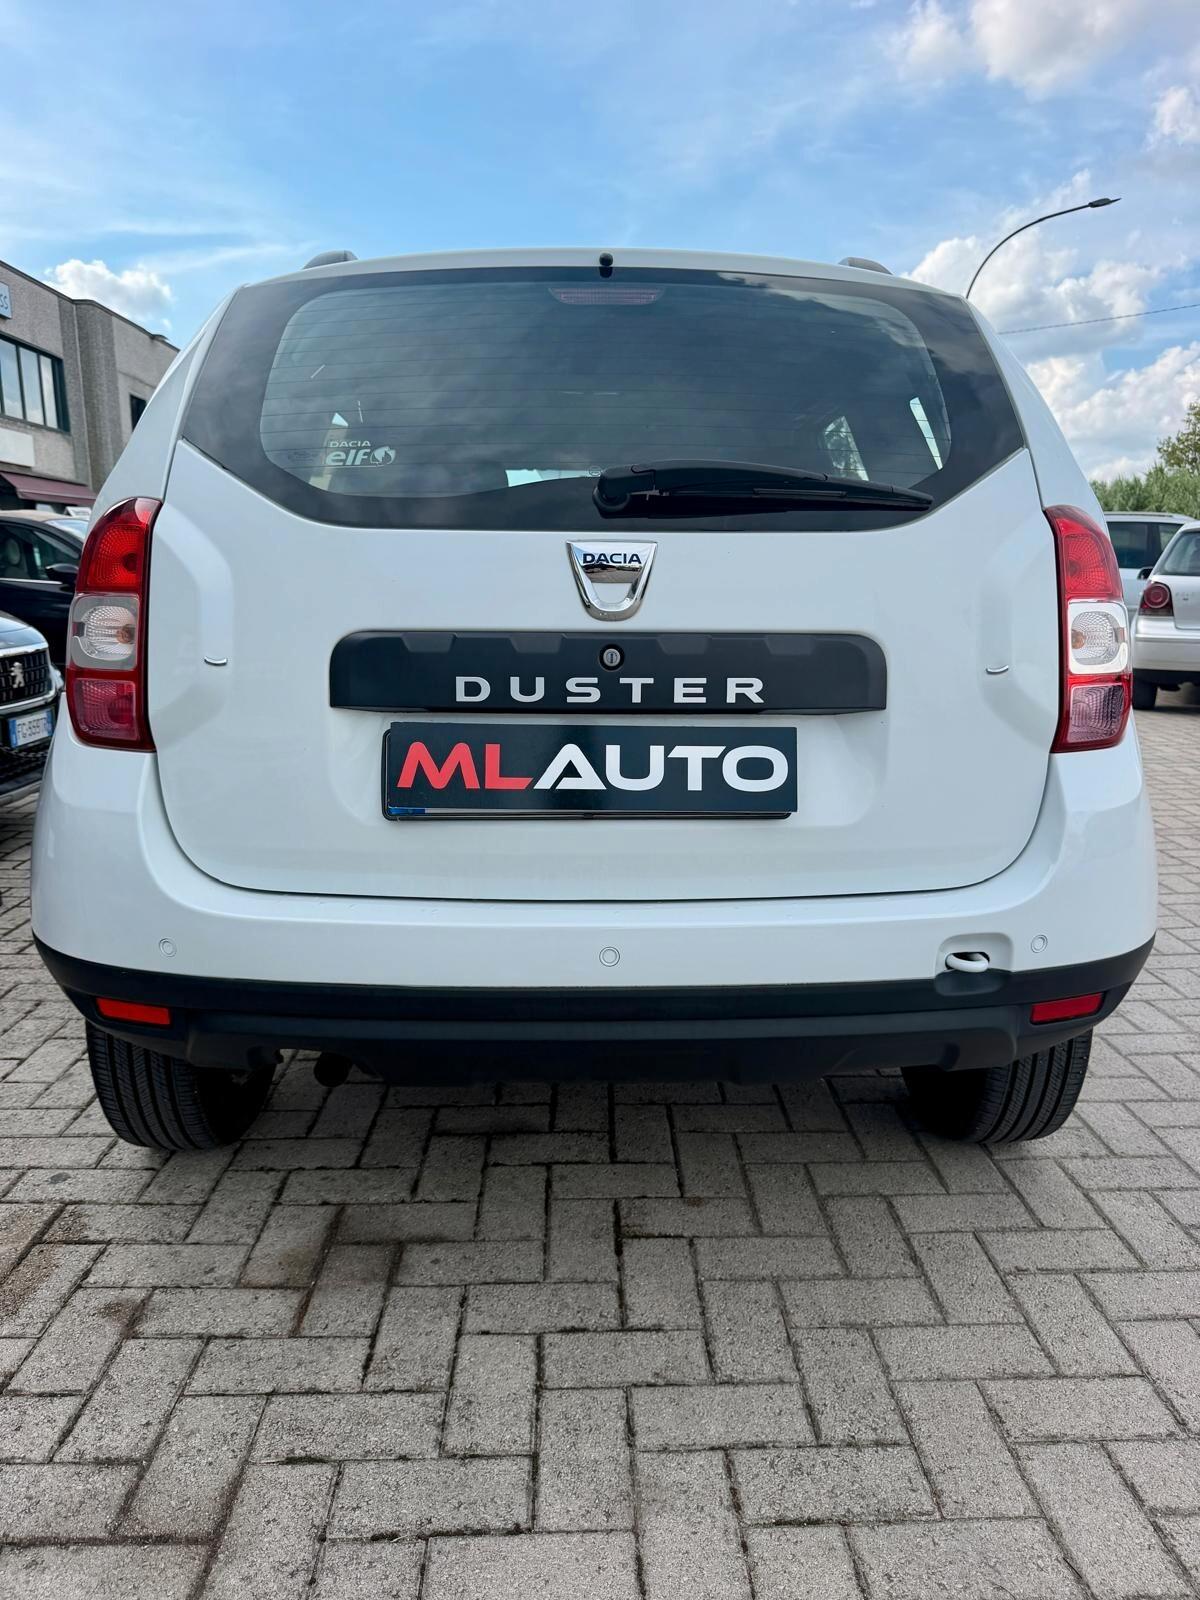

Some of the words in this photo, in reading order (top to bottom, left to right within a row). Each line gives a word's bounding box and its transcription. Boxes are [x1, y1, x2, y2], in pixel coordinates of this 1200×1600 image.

[329, 440, 371, 448] DACIA
[325, 448, 371, 466] elf
[582, 552, 642, 565] DACIA
[455, 676, 765, 704] DUSTER
